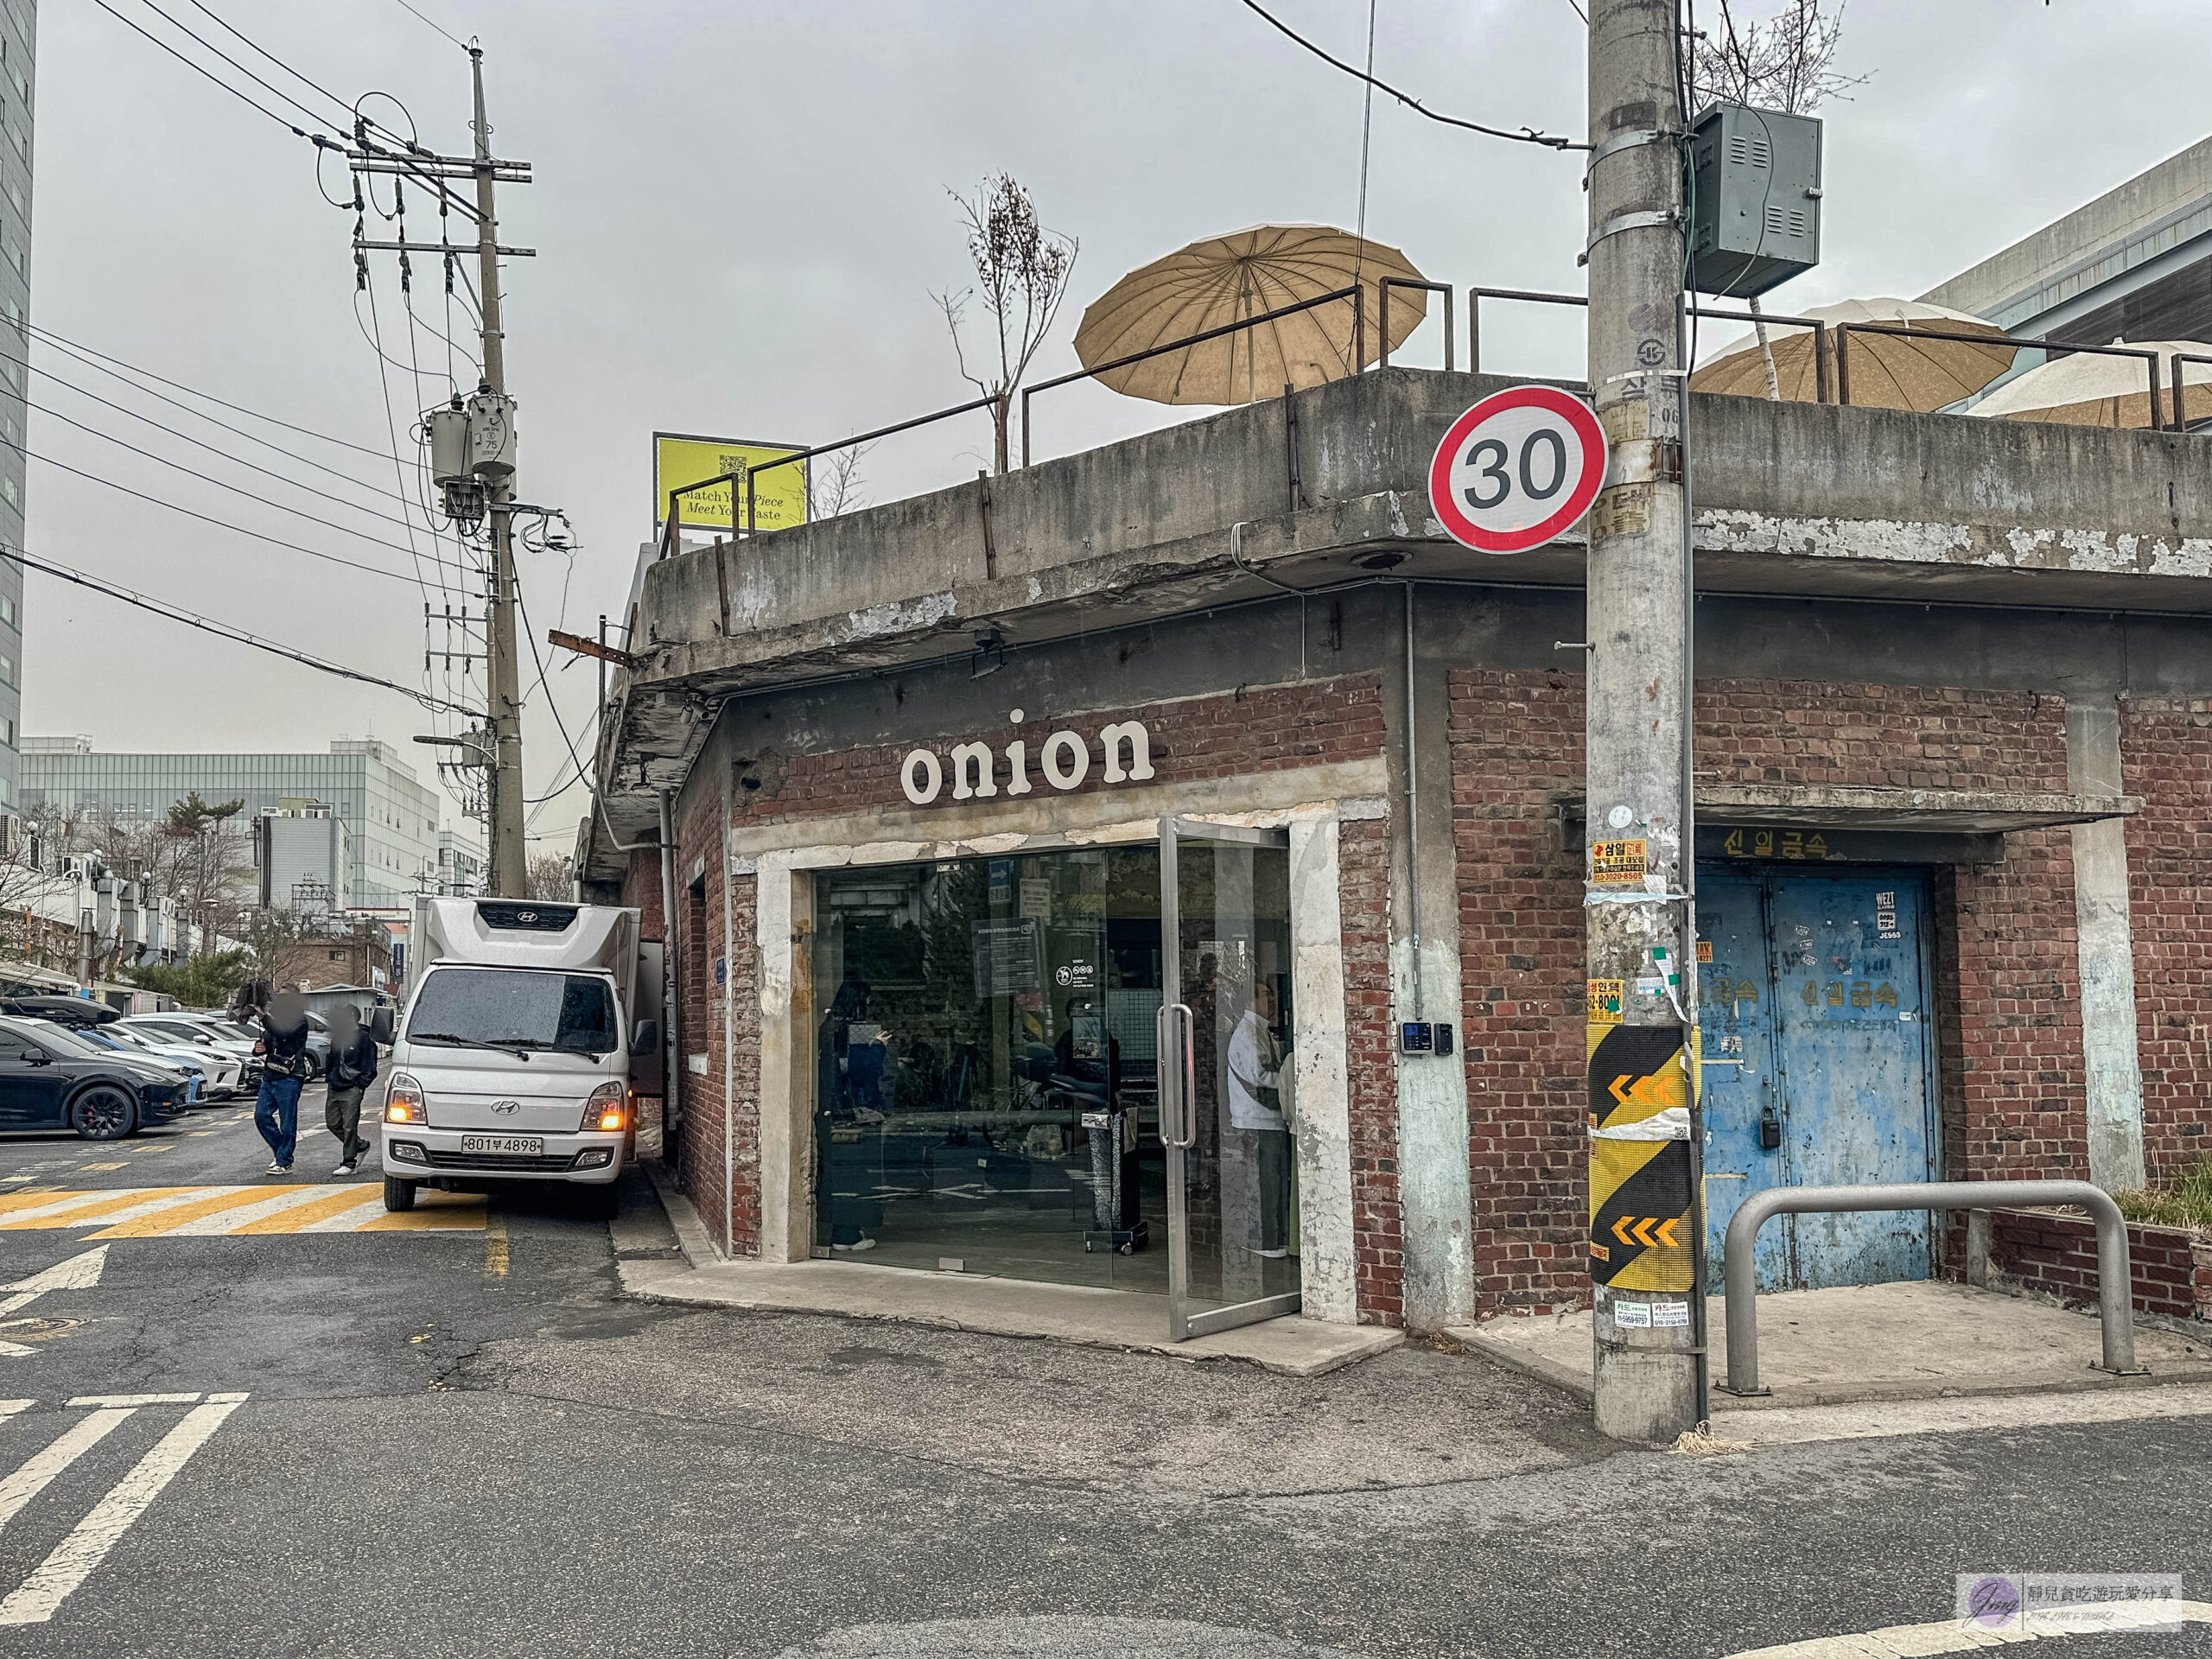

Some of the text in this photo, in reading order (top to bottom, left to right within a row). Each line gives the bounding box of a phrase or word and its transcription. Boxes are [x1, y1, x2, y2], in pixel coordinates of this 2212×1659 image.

[486, 440, 498, 449] 75
[1465, 429, 1567, 509] 30
[683, 490, 721, 502] Match
[754, 494, 784, 508] Piece
[686, 501, 781, 520] Meet Yor aste
[900, 708, 1154, 804] onion
[1605, 842, 1625, 856] 삼일
